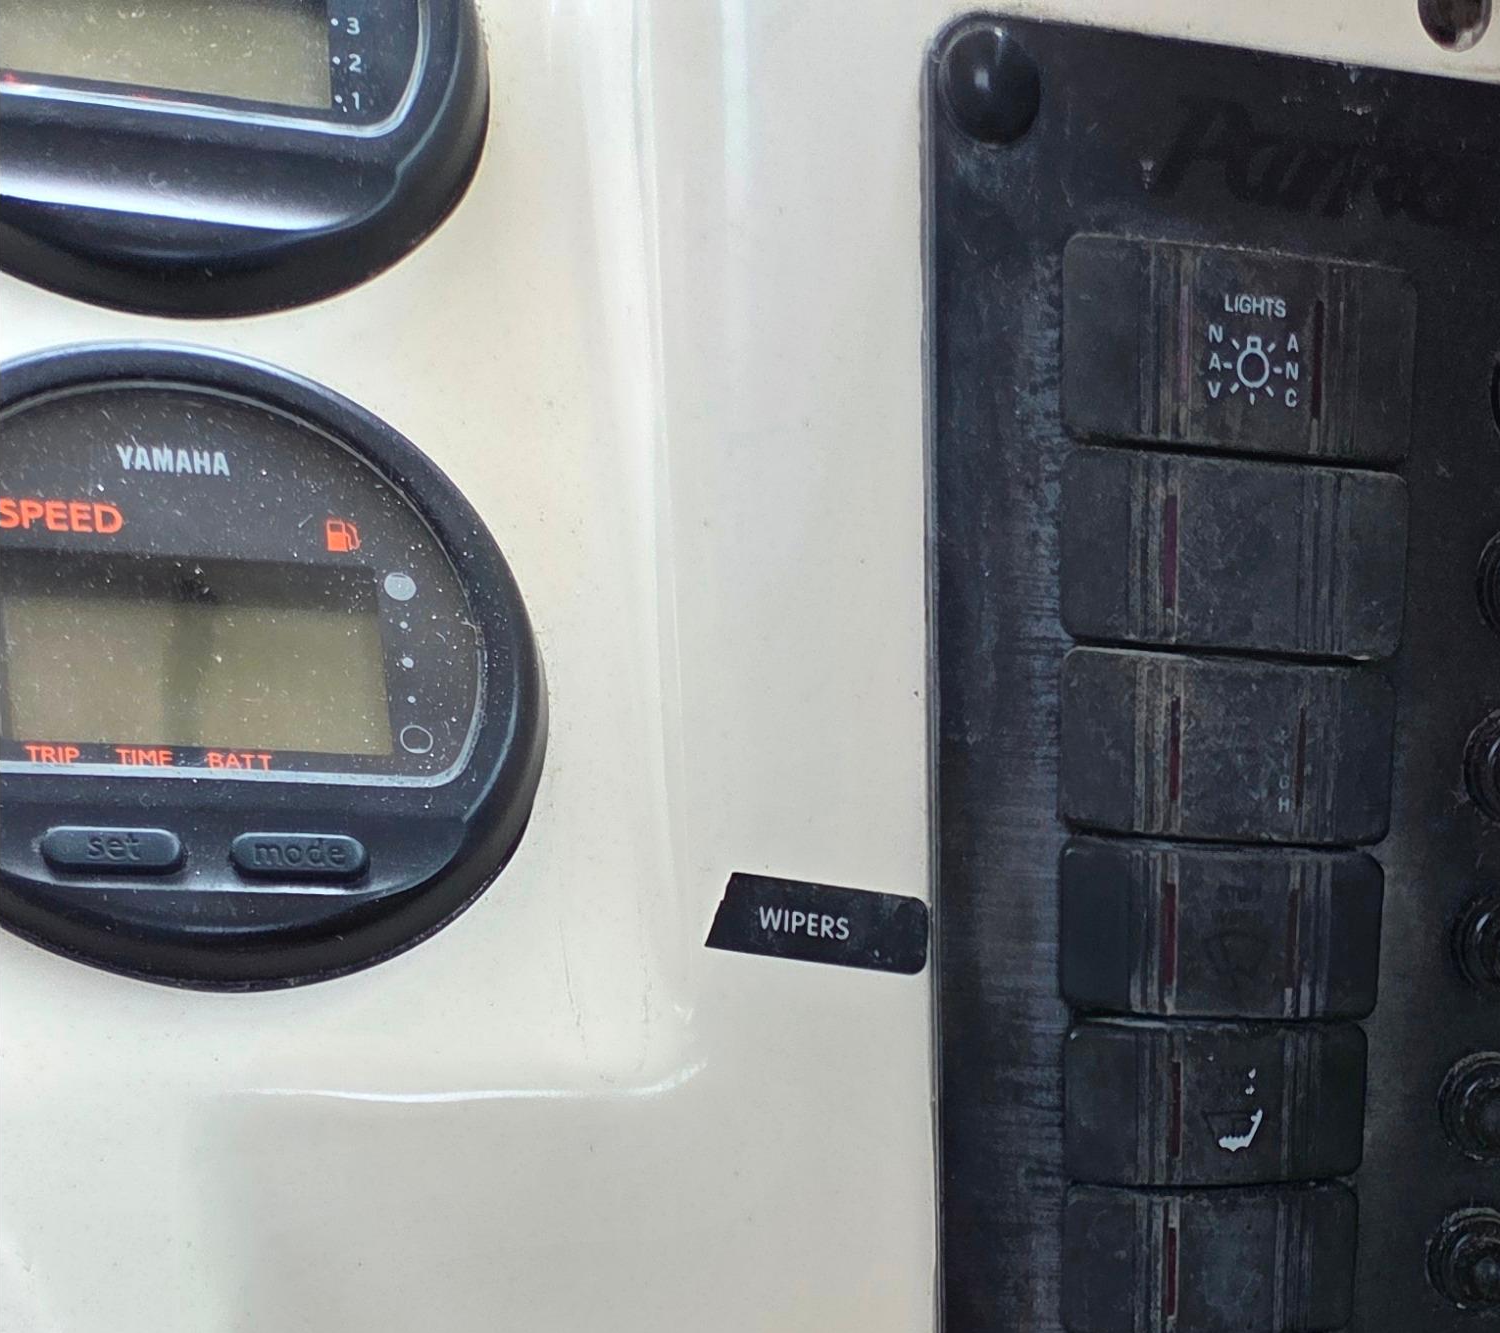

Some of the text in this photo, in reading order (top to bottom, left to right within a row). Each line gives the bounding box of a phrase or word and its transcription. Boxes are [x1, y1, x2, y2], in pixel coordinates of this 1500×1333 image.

[347, 18, 361, 35] 3
[348, 54, 362, 73] 2
[353, 92, 361, 109] 1
[1224, 294, 1287, 319] LIGHTS
[116, 445, 230, 477] YAMAHA
[0, 497, 124, 534] SPEED
[26, 745, 273, 772] TRIP TIME BATT
[87, 833, 140, 861] set
[252, 838, 347, 867] mode
[758, 905, 850, 940] WIPERS
